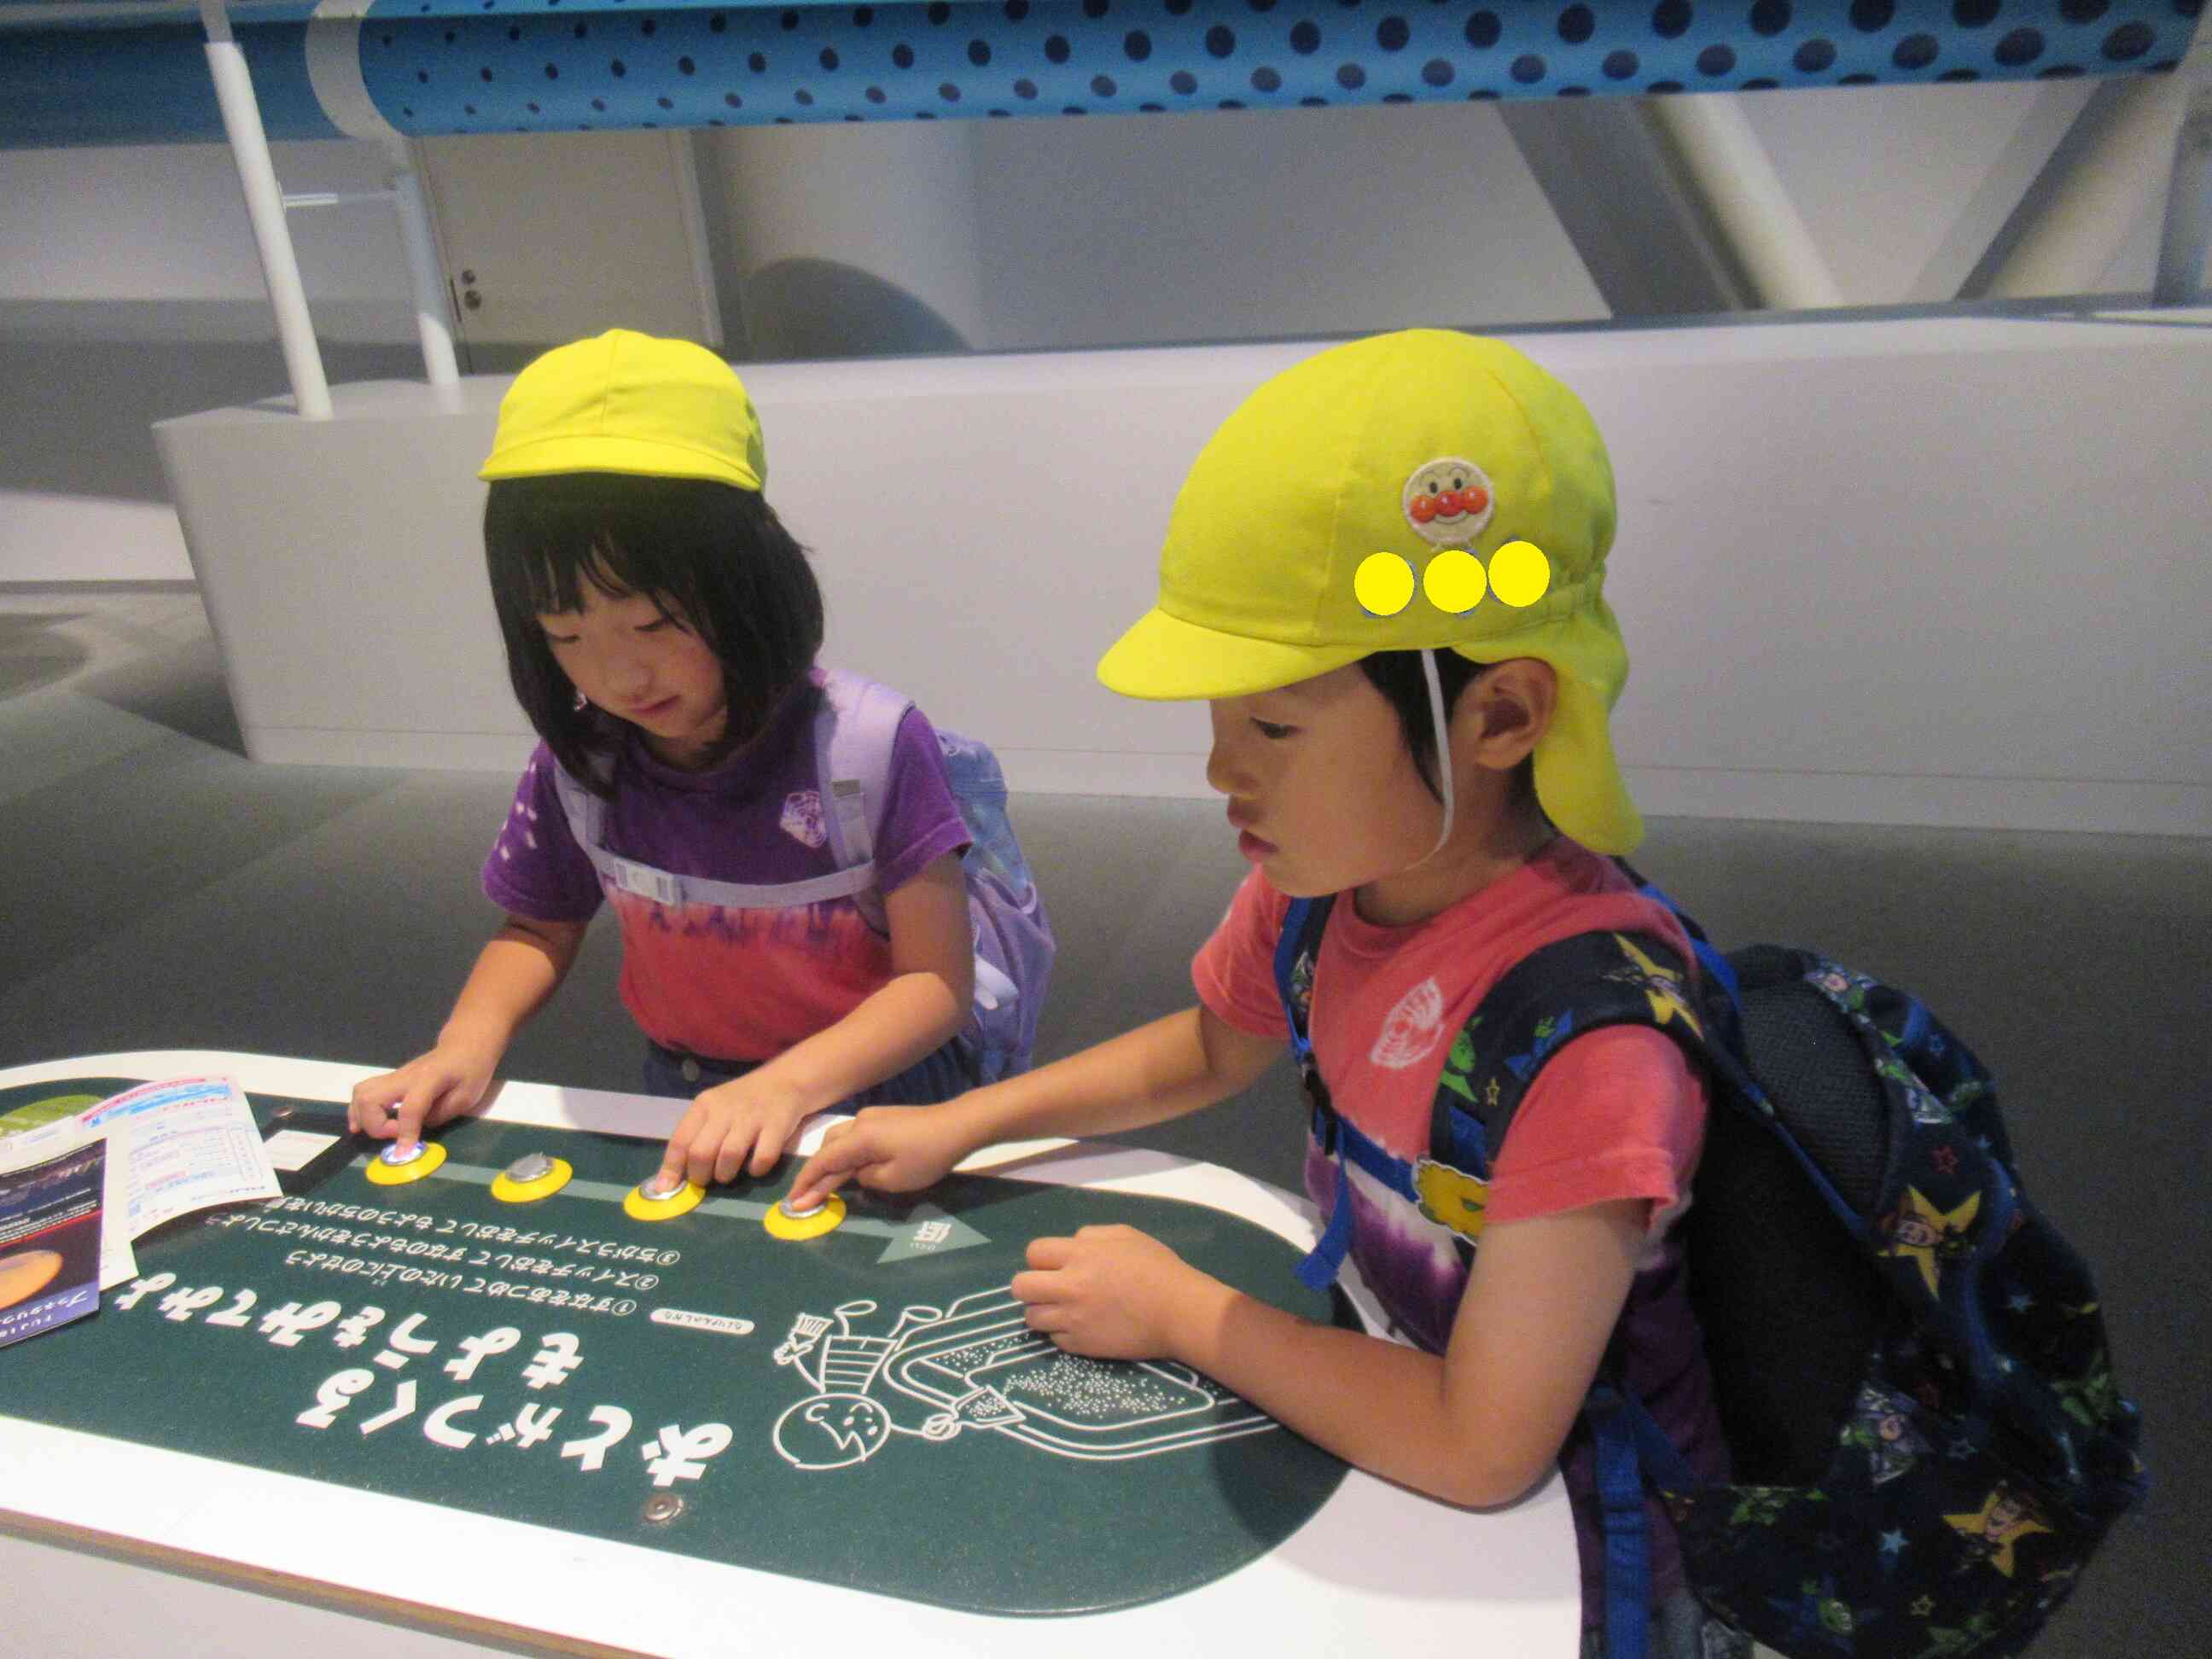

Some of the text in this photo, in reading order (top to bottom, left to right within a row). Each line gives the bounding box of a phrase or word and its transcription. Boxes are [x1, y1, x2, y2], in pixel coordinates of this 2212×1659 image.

[297, 1369, 733, 1487] おとがつくる
